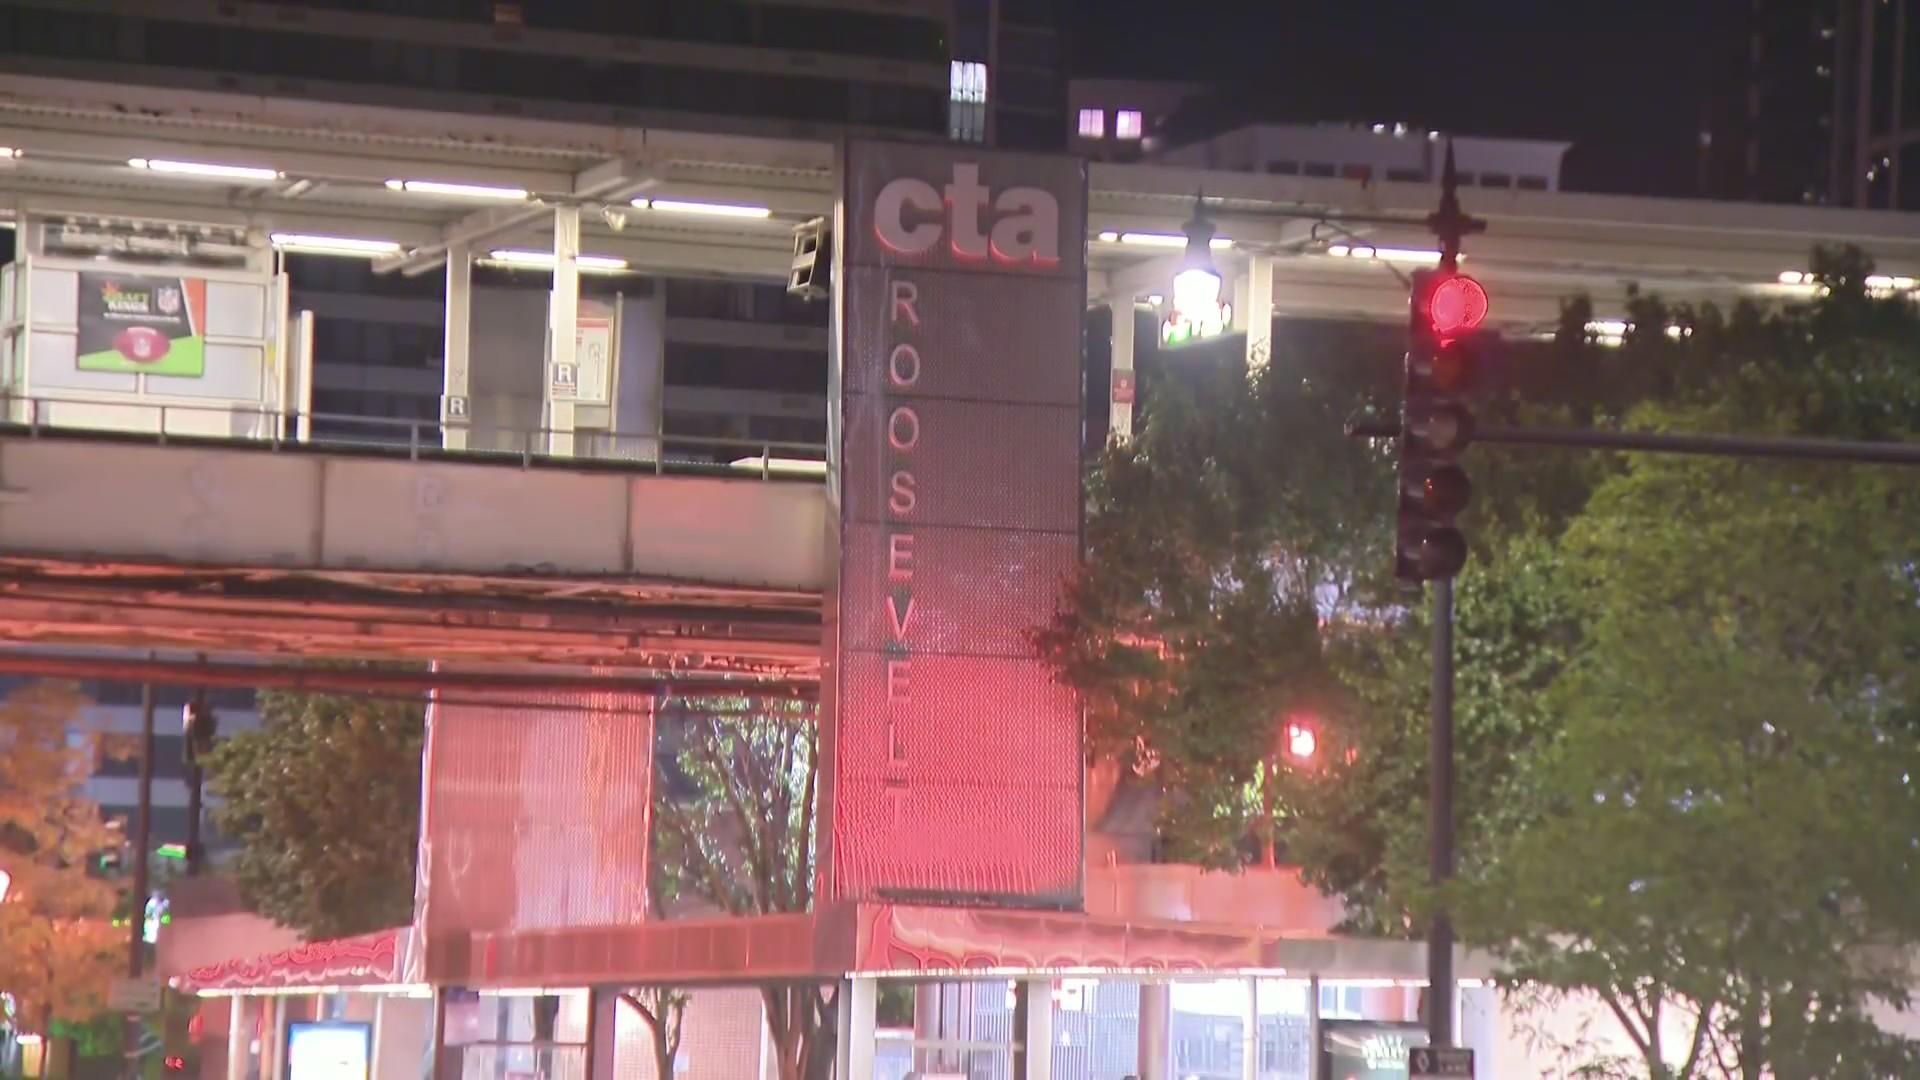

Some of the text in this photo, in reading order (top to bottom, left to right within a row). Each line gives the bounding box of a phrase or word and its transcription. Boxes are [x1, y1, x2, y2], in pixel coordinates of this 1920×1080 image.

[873, 163, 1060, 263] cta
[558, 364, 572, 382] R
[450, 397, 464, 414] R
[886, 281, 920, 828] ROOSEVELT
